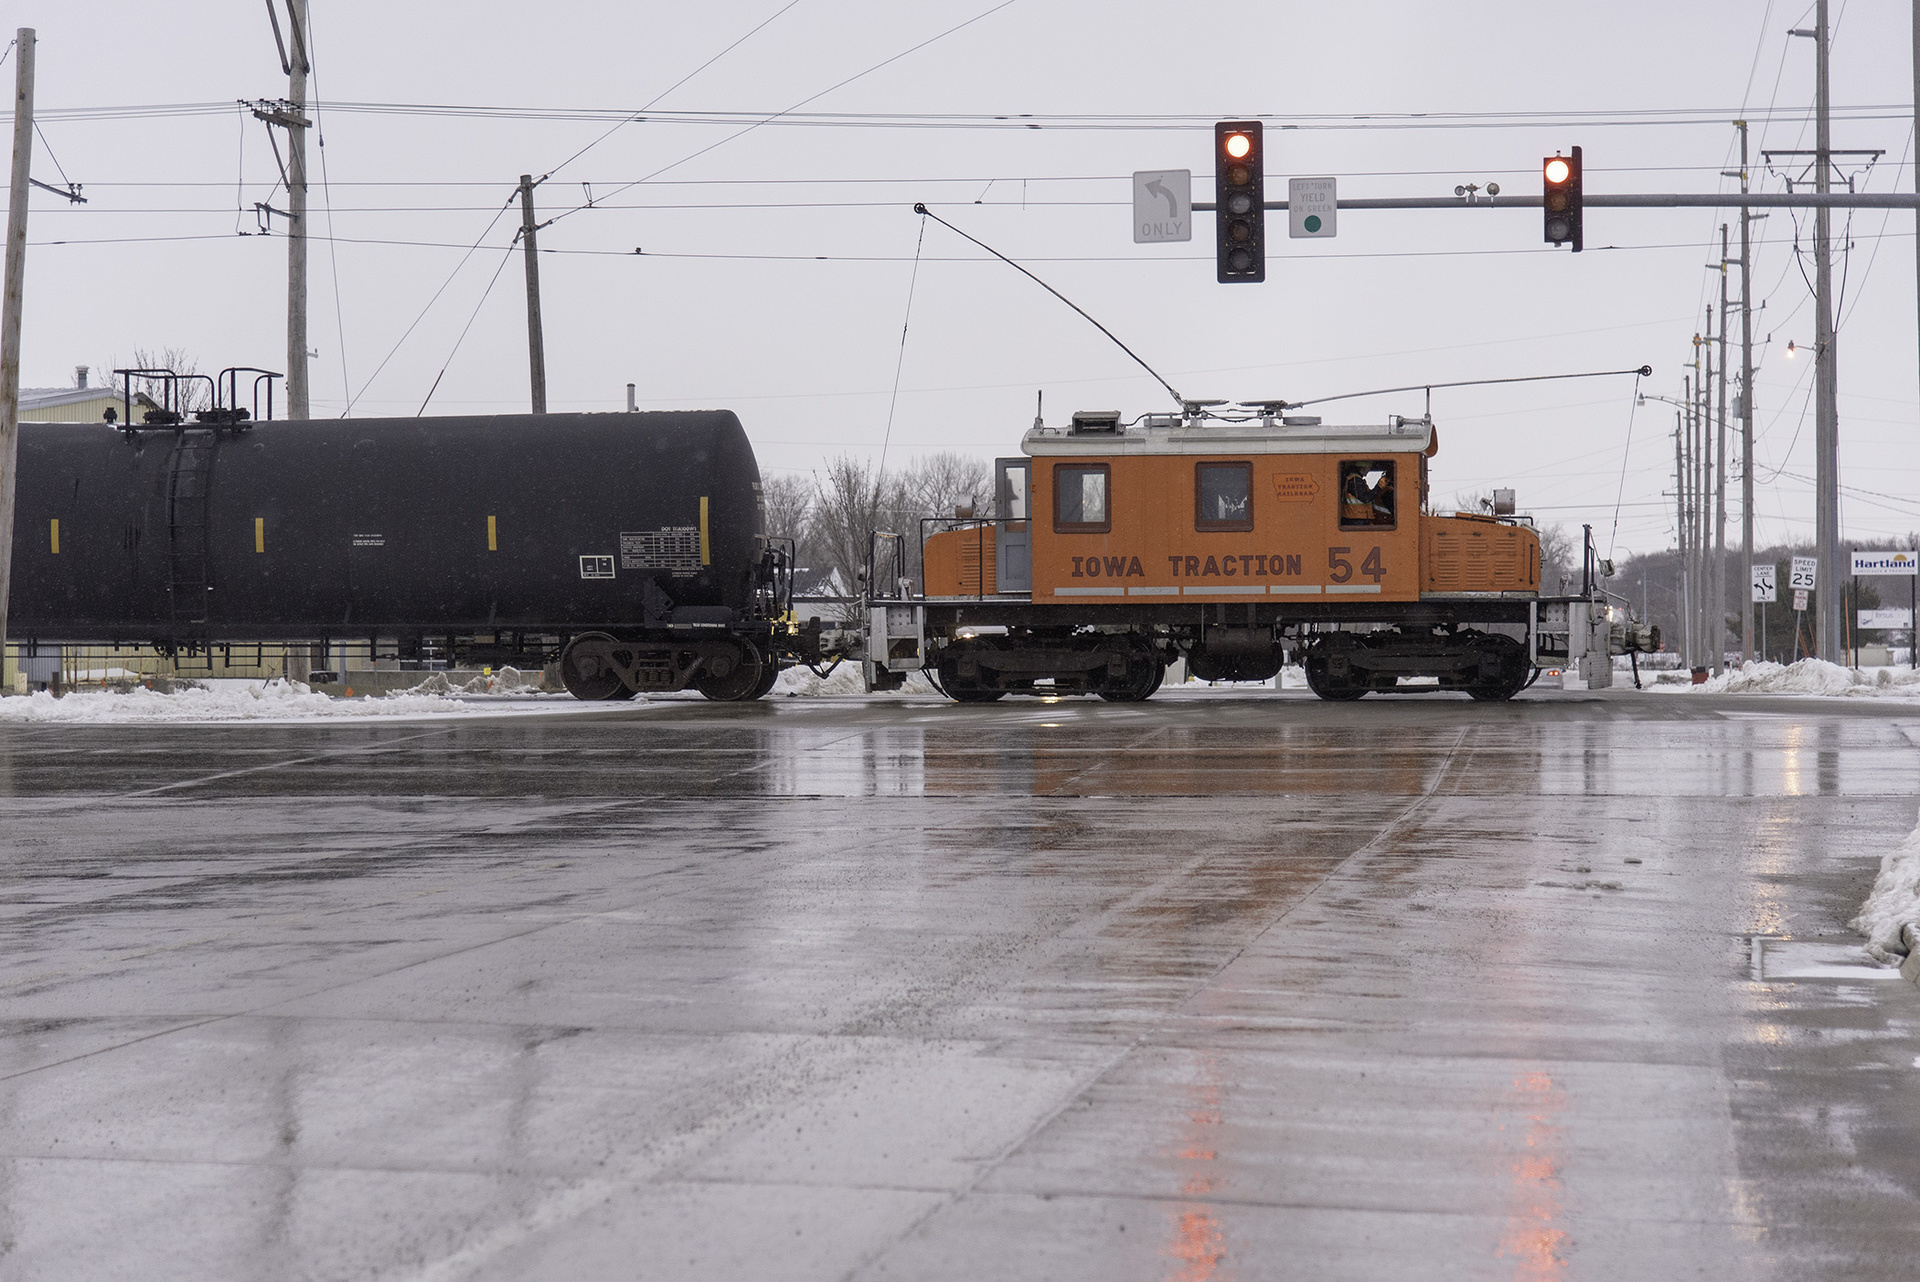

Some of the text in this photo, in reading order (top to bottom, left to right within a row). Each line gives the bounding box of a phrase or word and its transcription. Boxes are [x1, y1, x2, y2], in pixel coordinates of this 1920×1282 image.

[1292, 182, 1333, 191] LEFT TURN
[1301, 193, 1325, 202] YIELD
[1294, 204, 1332, 213] ON GREEN
[1142, 221, 1183, 236] ONLY
[1071, 554, 1302, 577] IOWA TRACTION
[1328, 546, 1387, 583] 54
[1794, 559, 1816, 567] SPEED
[1855, 559, 1915, 568] Hartland
[1792, 573, 1814, 586] 25
